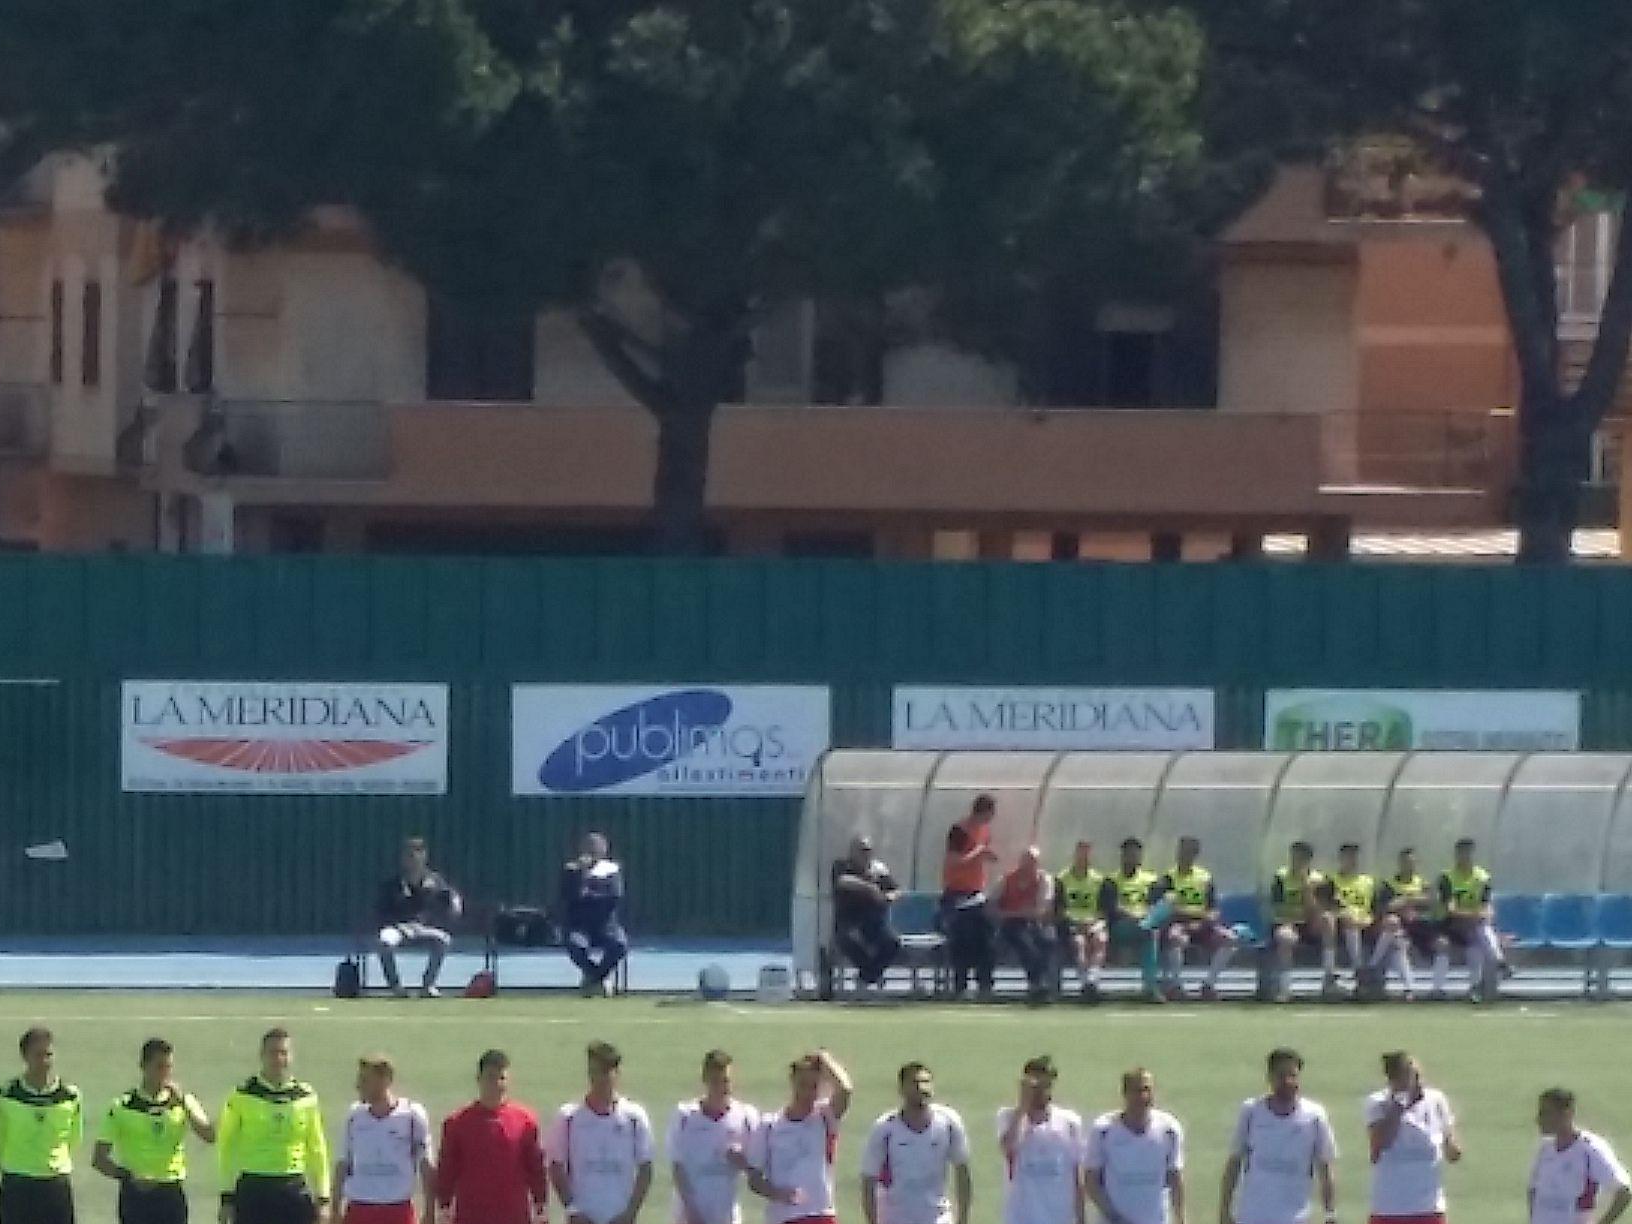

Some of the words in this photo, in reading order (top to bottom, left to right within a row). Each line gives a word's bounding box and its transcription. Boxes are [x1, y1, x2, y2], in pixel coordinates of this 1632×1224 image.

[131, 694, 188, 725] LA
[197, 695, 435, 727] MERIDIANA
[906, 700, 960, 731] LA
[970, 700, 1203, 732] MERIDIANA
